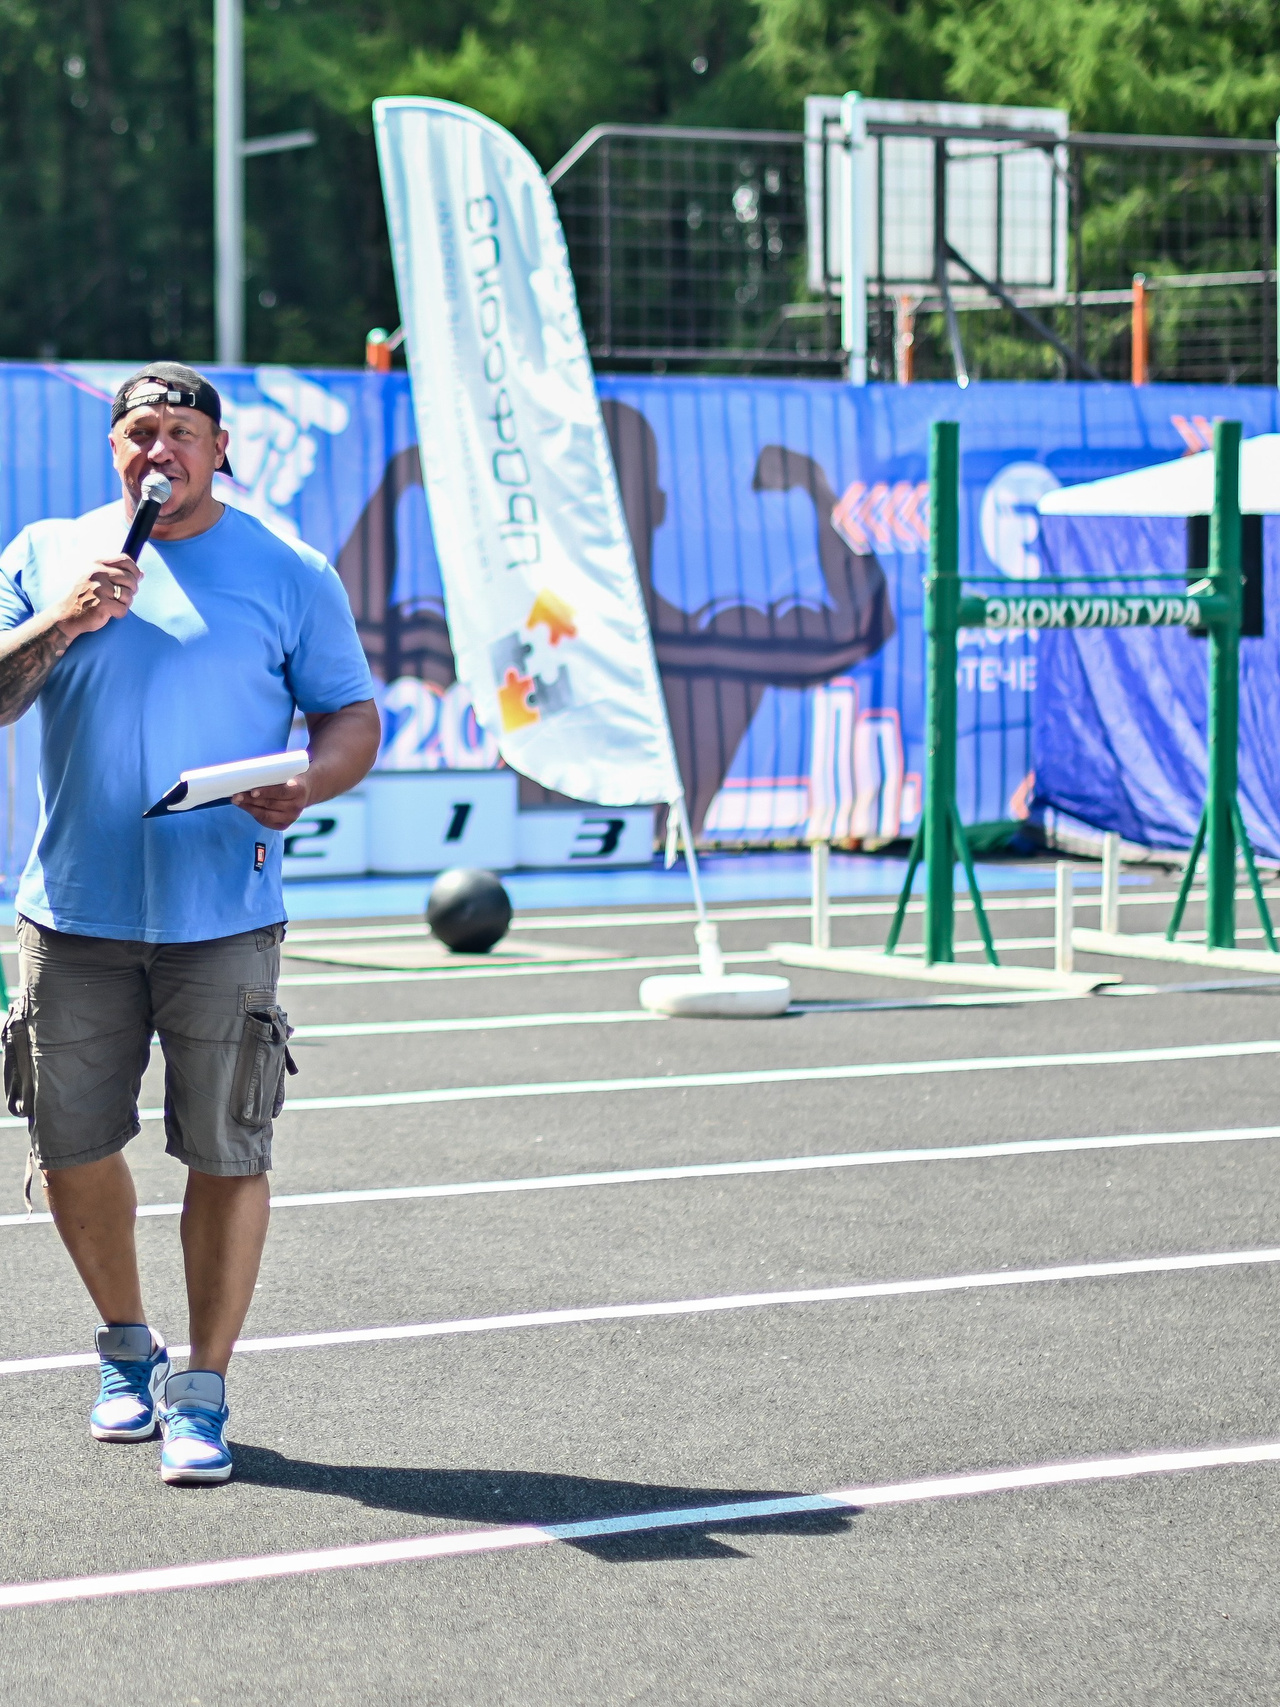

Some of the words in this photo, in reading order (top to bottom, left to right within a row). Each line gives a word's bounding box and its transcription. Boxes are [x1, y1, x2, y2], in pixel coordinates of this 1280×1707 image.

[984, 598, 1201, 628] ЭКОКУЛЬТУРА
[957, 656, 1038, 692] ТЕЧЕ
[284, 817, 337, 859] 2
[444, 802, 473, 843] 1
[569, 817, 625, 860] 3
